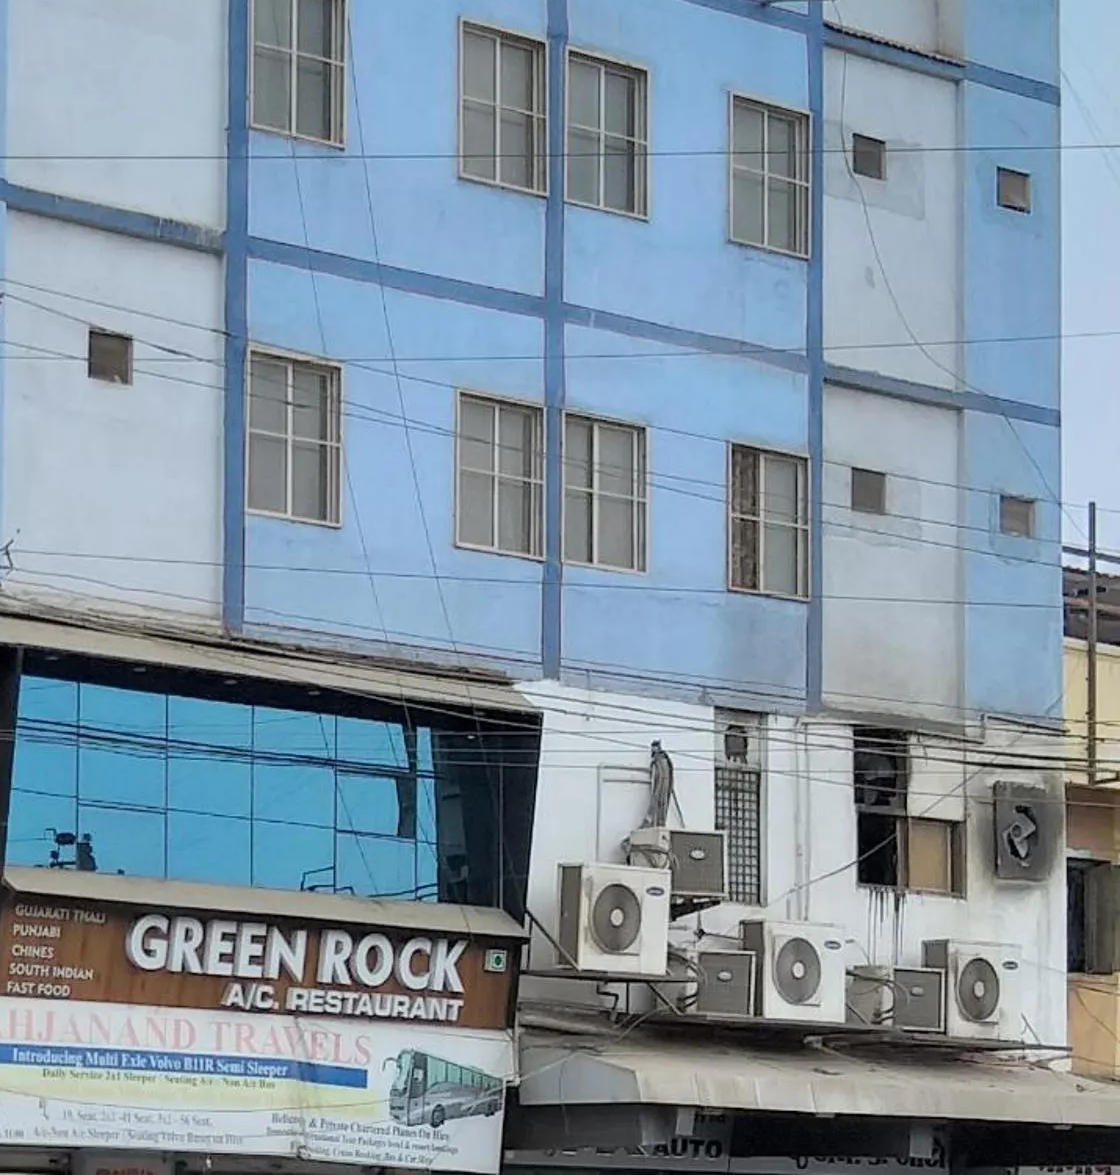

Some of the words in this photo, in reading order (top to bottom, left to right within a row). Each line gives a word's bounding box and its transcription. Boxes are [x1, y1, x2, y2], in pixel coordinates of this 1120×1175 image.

[12, 923, 61, 937] PUNJABI
[11, 944, 55, 958] CHINES
[126, 913, 307, 983] GREEN
[318, 929, 468, 994] ROCK
[8, 962, 49, 977] SOUTH
[52, 966, 94, 980] INDIAN
[6, 981, 36, 994] FAST
[37, 984, 71, 997] FOOD
[286, 987, 464, 1022] RESTAURANT
[210, 1019, 371, 1066] TRAVELS
[13, 1046, 82, 1067] Introducing
[86, 1052, 119, 1068] Multi
[150, 1055, 181, 1070] Volvo
[216, 1059, 245, 1074] Semi
[247, 1061, 289, 1079] Sleeper
[653, 1138, 723, 1159] AUTO
